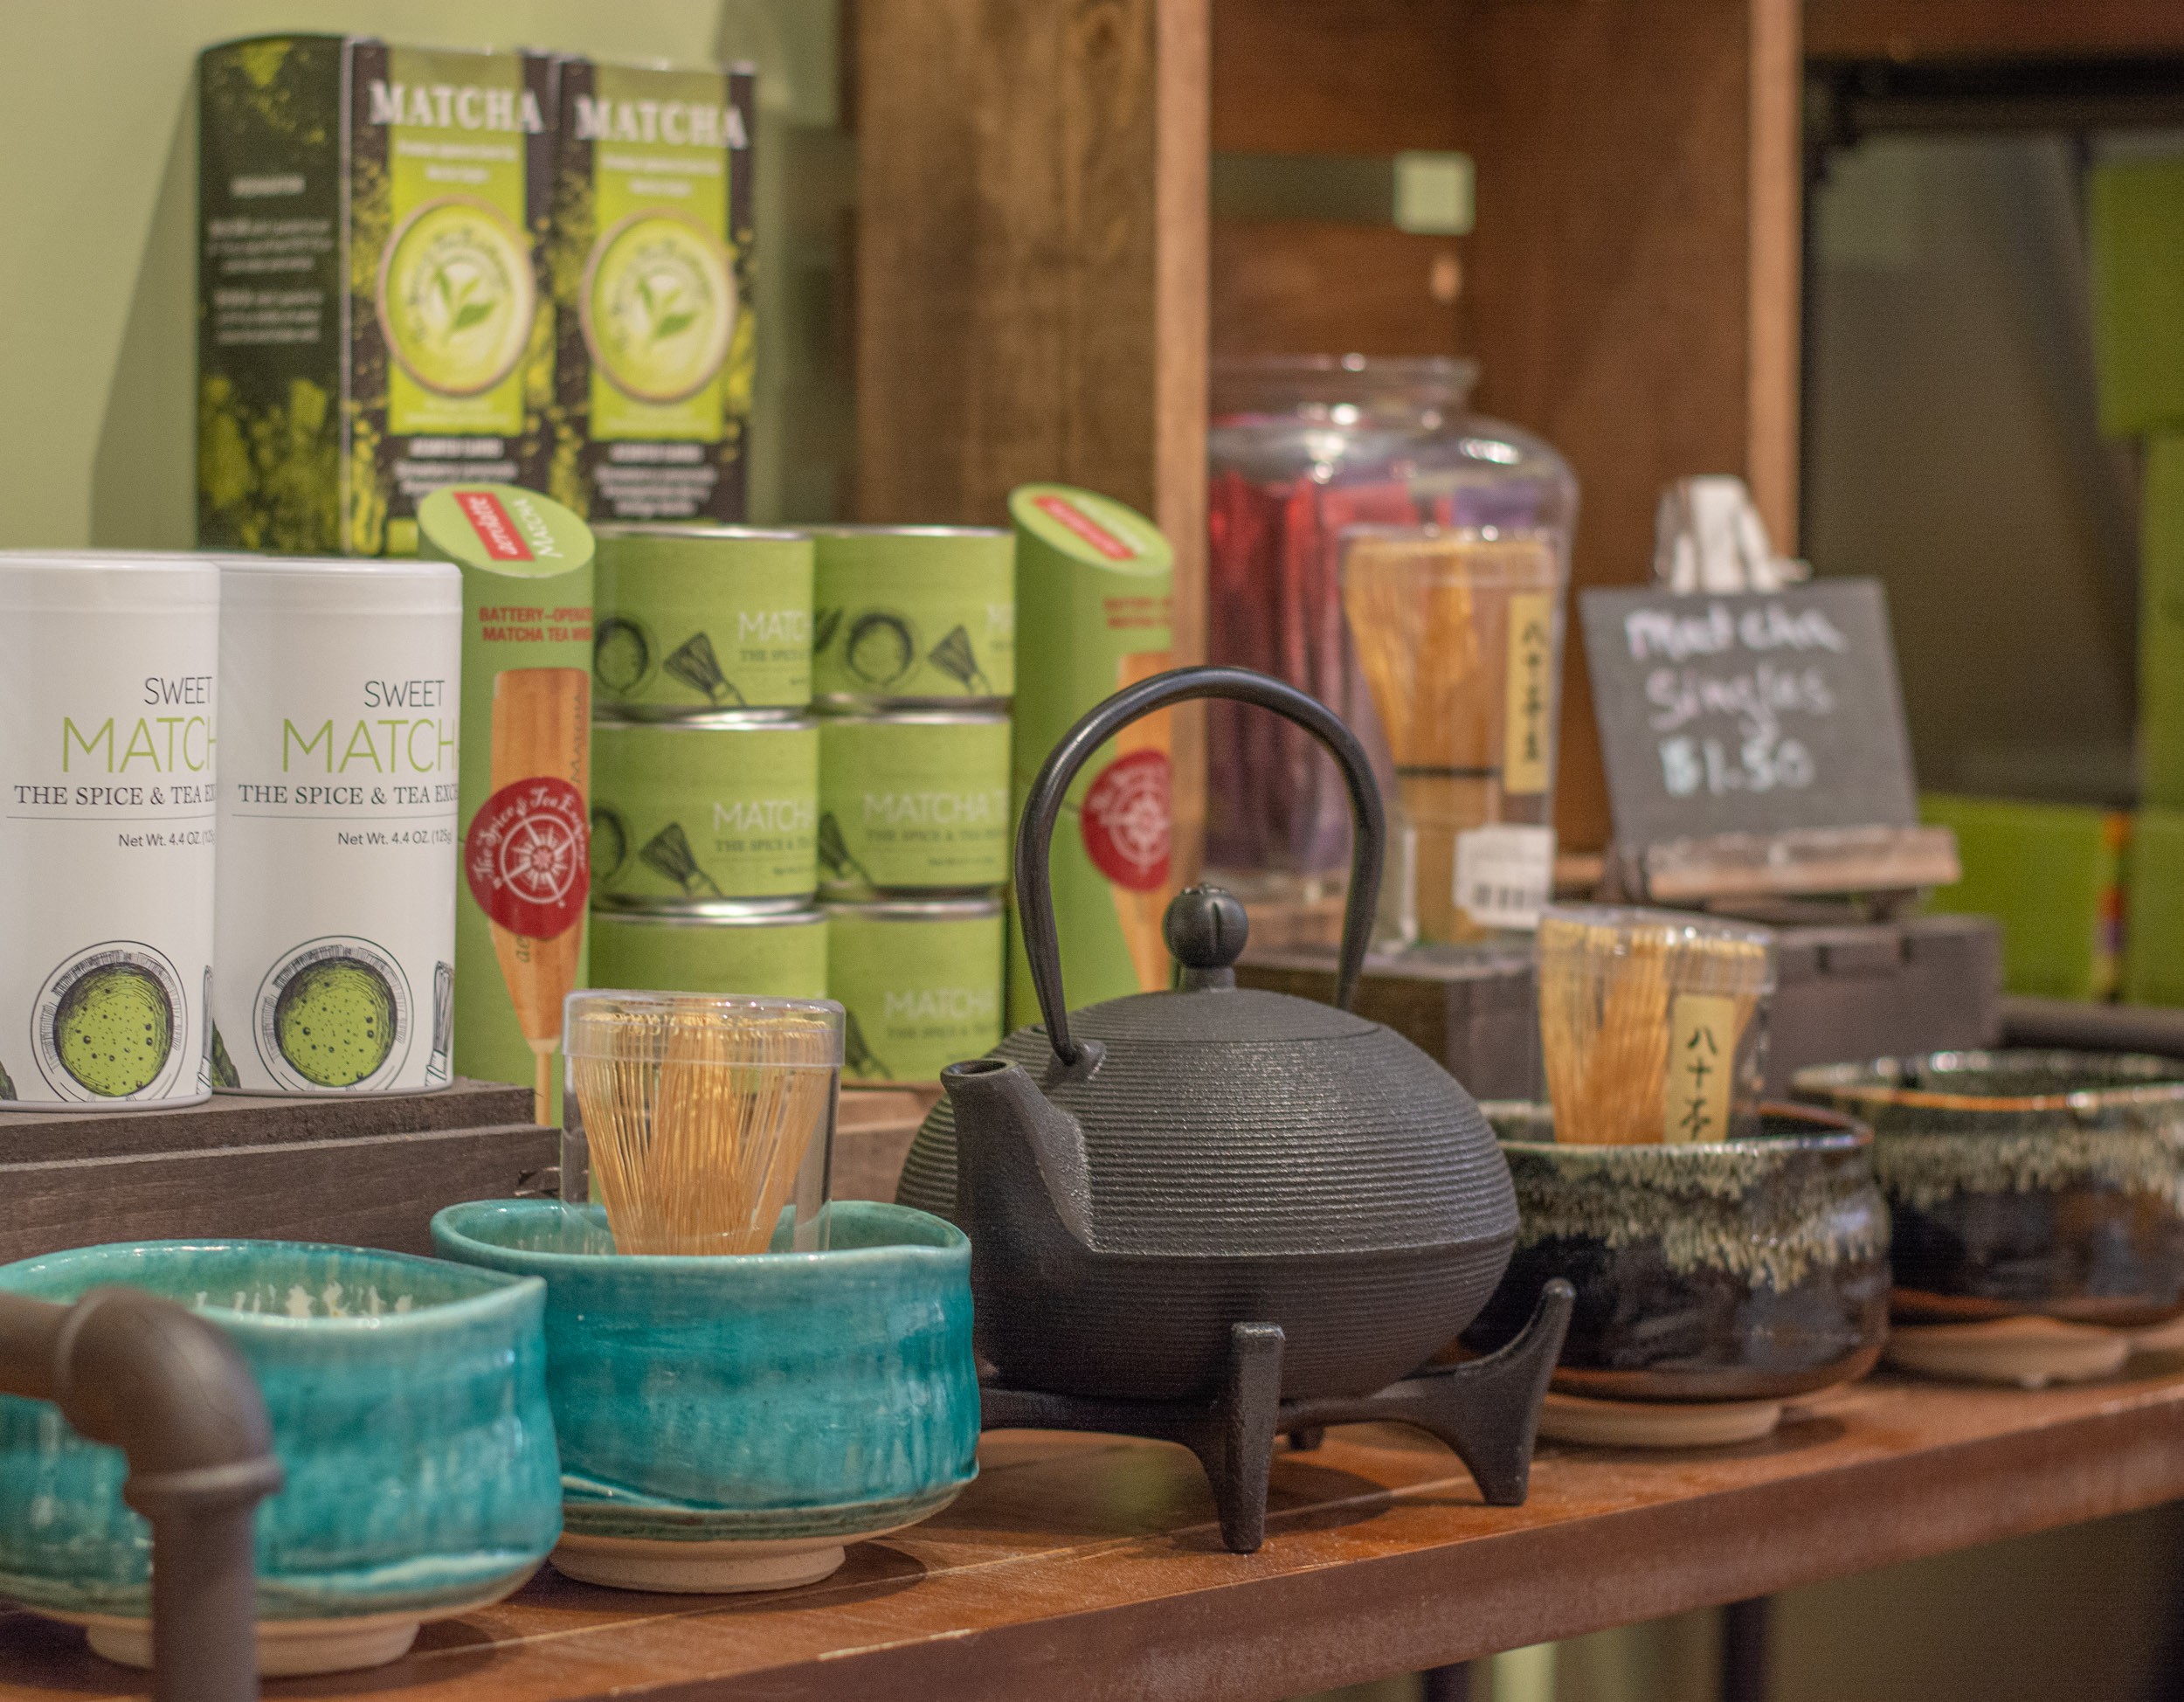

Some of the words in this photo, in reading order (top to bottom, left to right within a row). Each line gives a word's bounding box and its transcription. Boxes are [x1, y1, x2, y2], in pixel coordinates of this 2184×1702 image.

[369, 80, 545, 134] MATCHA
[576, 94, 749, 149] MATCHA
[482, 626, 545, 641] MATCHA
[143, 676, 213, 705] SWEET
[363, 680, 446, 708] SWEET
[14, 785, 68, 806] THE
[76, 786, 143, 806] SPICE
[150, 786, 166, 806] &
[171, 785, 202, 805] TEA
[238, 783, 288, 804] THE
[295, 785, 363, 806] SPICE
[370, 786, 388, 805] &
[394, 785, 431, 804] TEA
[119, 834, 143, 847] Net
[146, 833, 167, 847] Wt.
[169, 832, 184, 846] 4.4
[338, 832, 363, 845] Net
[366, 831, 389, 845] Wt.
[391, 831, 410, 845] 4.4
